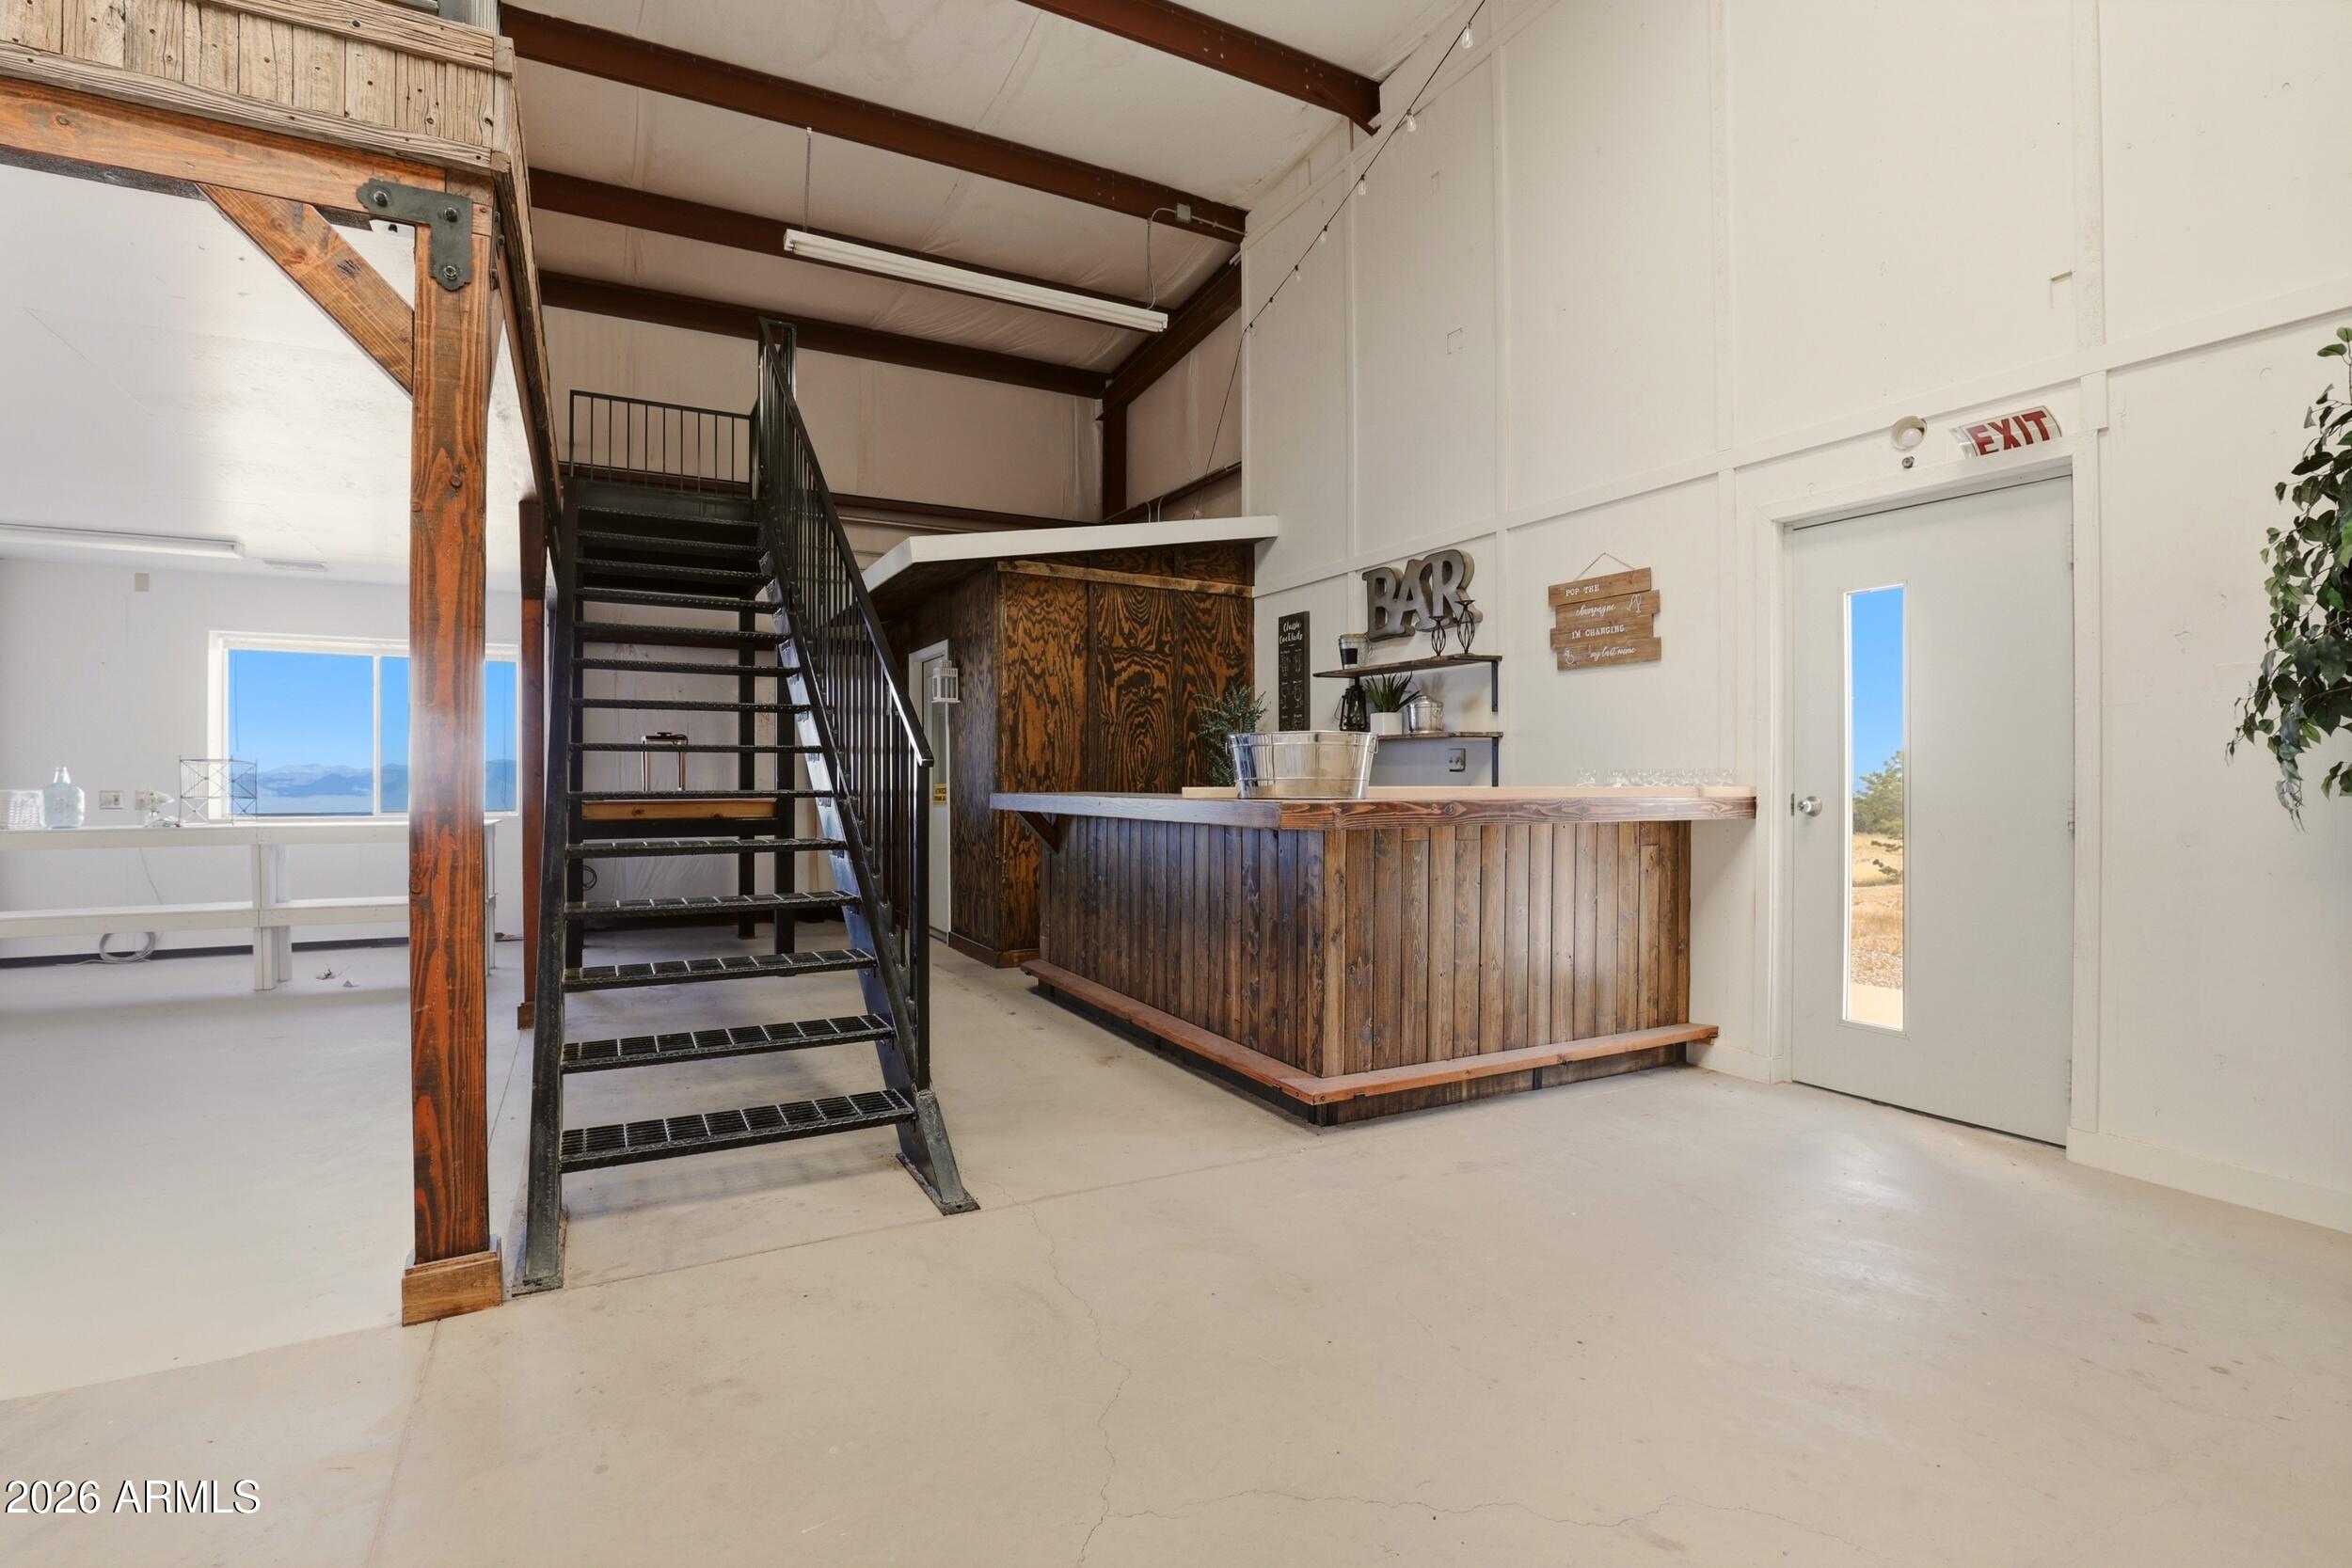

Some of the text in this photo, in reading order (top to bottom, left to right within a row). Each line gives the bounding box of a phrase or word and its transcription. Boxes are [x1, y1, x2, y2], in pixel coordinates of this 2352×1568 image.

[1965, 410, 2050, 455] EXIT
[1361, 549, 1483, 642] BAR
[1565, 584, 1599, 596] POP THE
[1585, 625, 1625, 636] CHANGING
